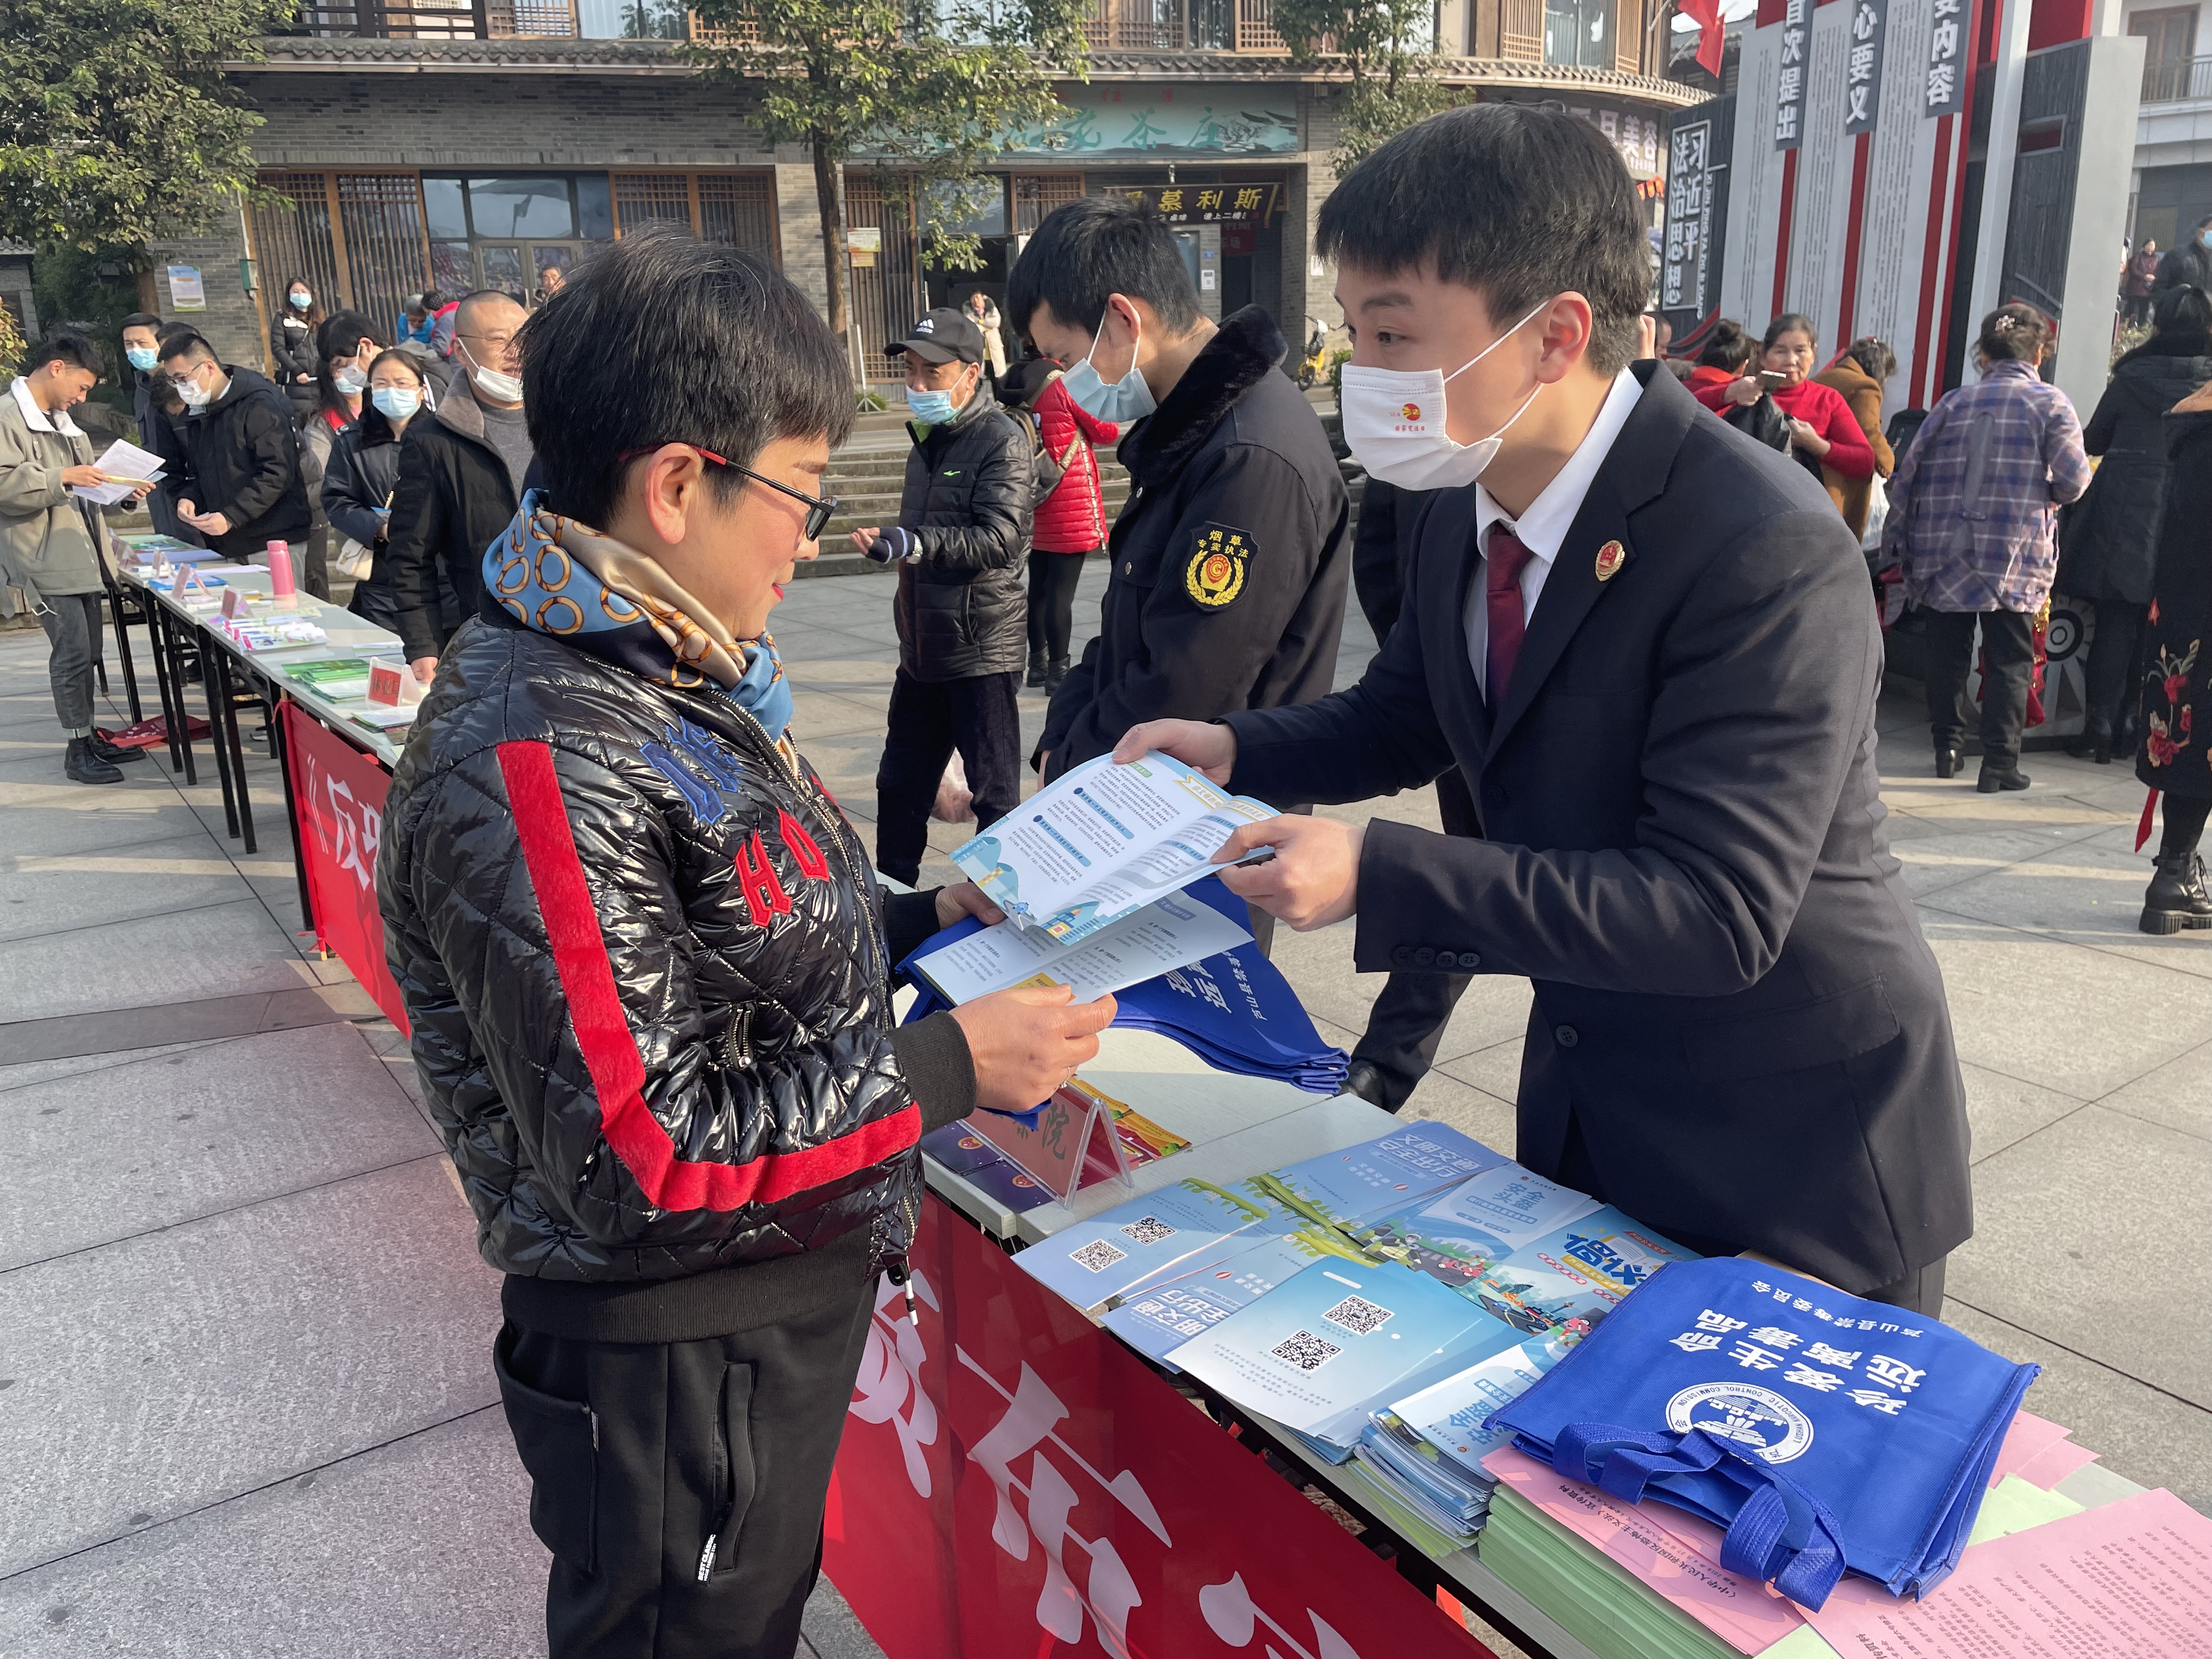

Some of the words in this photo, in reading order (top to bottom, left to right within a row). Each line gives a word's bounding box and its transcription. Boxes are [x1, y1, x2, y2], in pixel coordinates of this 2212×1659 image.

[1684, 129, 1705, 261] 习近平
[1666, 132, 1690, 305] 法治思想
[1198, 539, 1249, 558] 专卖执法
[1209, 529, 1243, 546] 烟草
[1375, 1138, 1461, 1180] 安全出行
[1395, 1132, 1483, 1175] 文明交通
[1492, 1190, 1537, 1212] 头盔
[1504, 1181, 1547, 1203] 安全
[1131, 1298, 1208, 1337] 明交通
[1155, 1289, 1231, 1324] 全出行
[1751, 1279, 1924, 1339] 芦山县禁毒委员会
[1692, 1308, 1928, 1394] 远离毒品
[1668, 1326, 1908, 1417] 珍爱生命
[1677, 1386, 1720, 1407] COMMISSION
[1723, 1386, 1763, 1397] CONTROL
[1449, 1408, 1500, 1448] 安全
[1769, 1397, 1801, 1425] NARCOTIC
[1427, 1424, 1457, 1446] 芦山公安交警
[1793, 1423, 1804, 1444] LUSHAN
